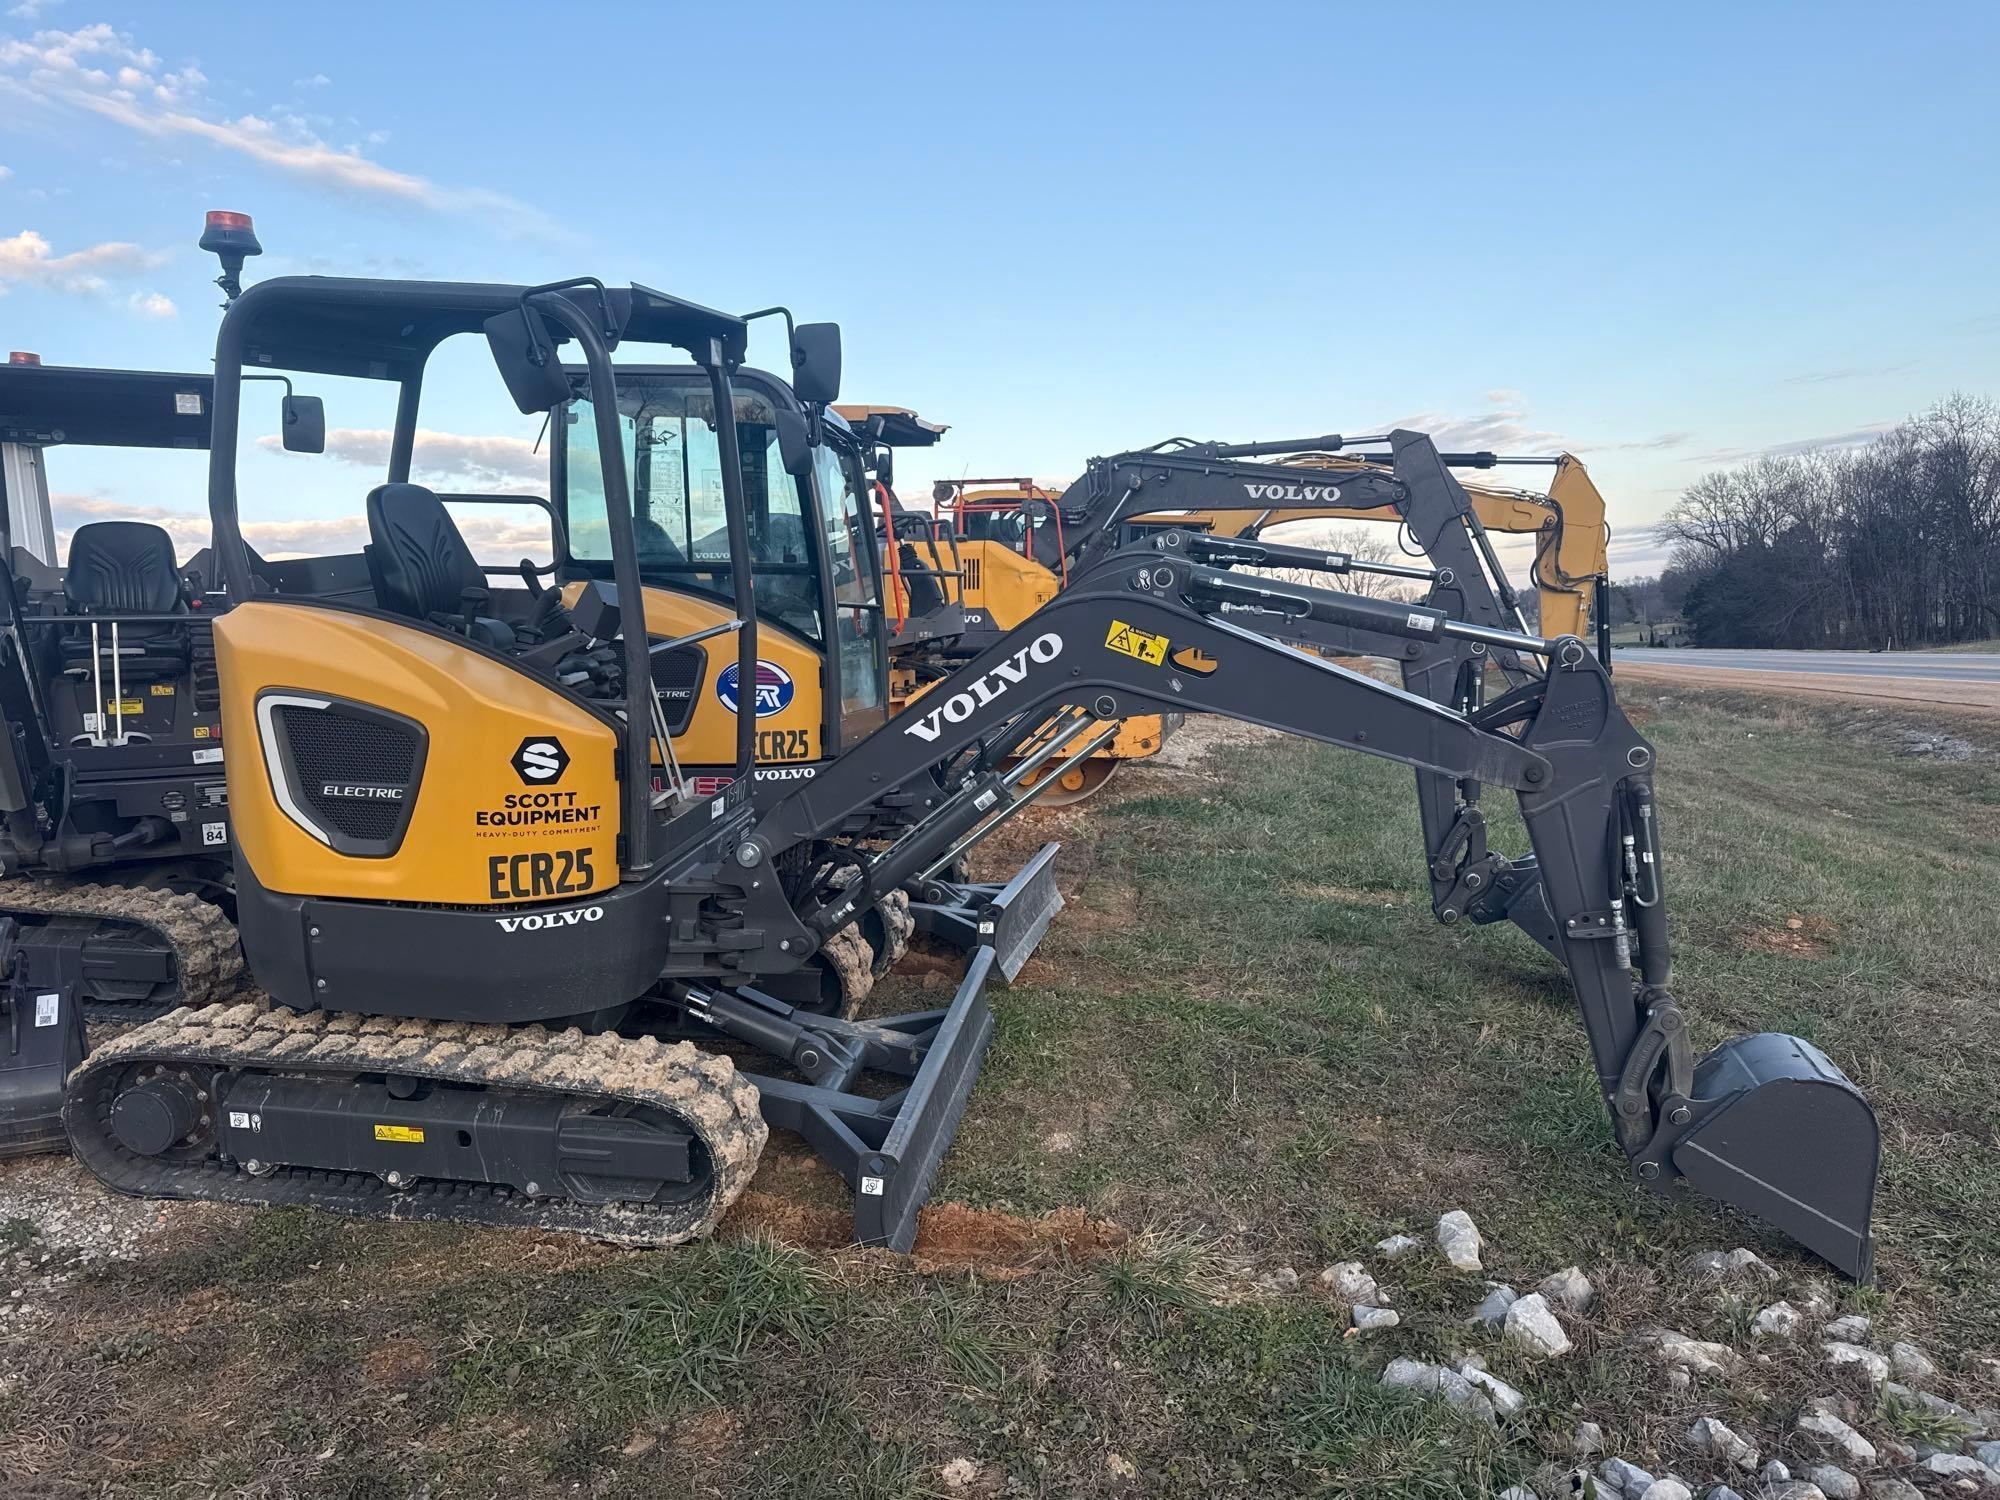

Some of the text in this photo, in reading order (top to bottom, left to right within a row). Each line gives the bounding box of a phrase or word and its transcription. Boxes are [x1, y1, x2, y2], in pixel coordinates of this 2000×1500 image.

[1243, 484, 1341, 501] VOLVO
[657, 690, 690, 698] CTRIC
[904, 633, 1063, 742] VOLVO
[522, 743, 560, 779] S
[754, 768, 816, 781] VOLVO
[323, 785, 403, 799] ELECTRIC
[504, 792, 577, 809] SCOTT
[476, 806, 601, 826] EQUIPMENT
[206, 830, 224, 842] 84
[543, 825, 600, 836] COMMITMENT
[489, 847, 594, 899] ECR25
[495, 906, 604, 933] VOLVO
